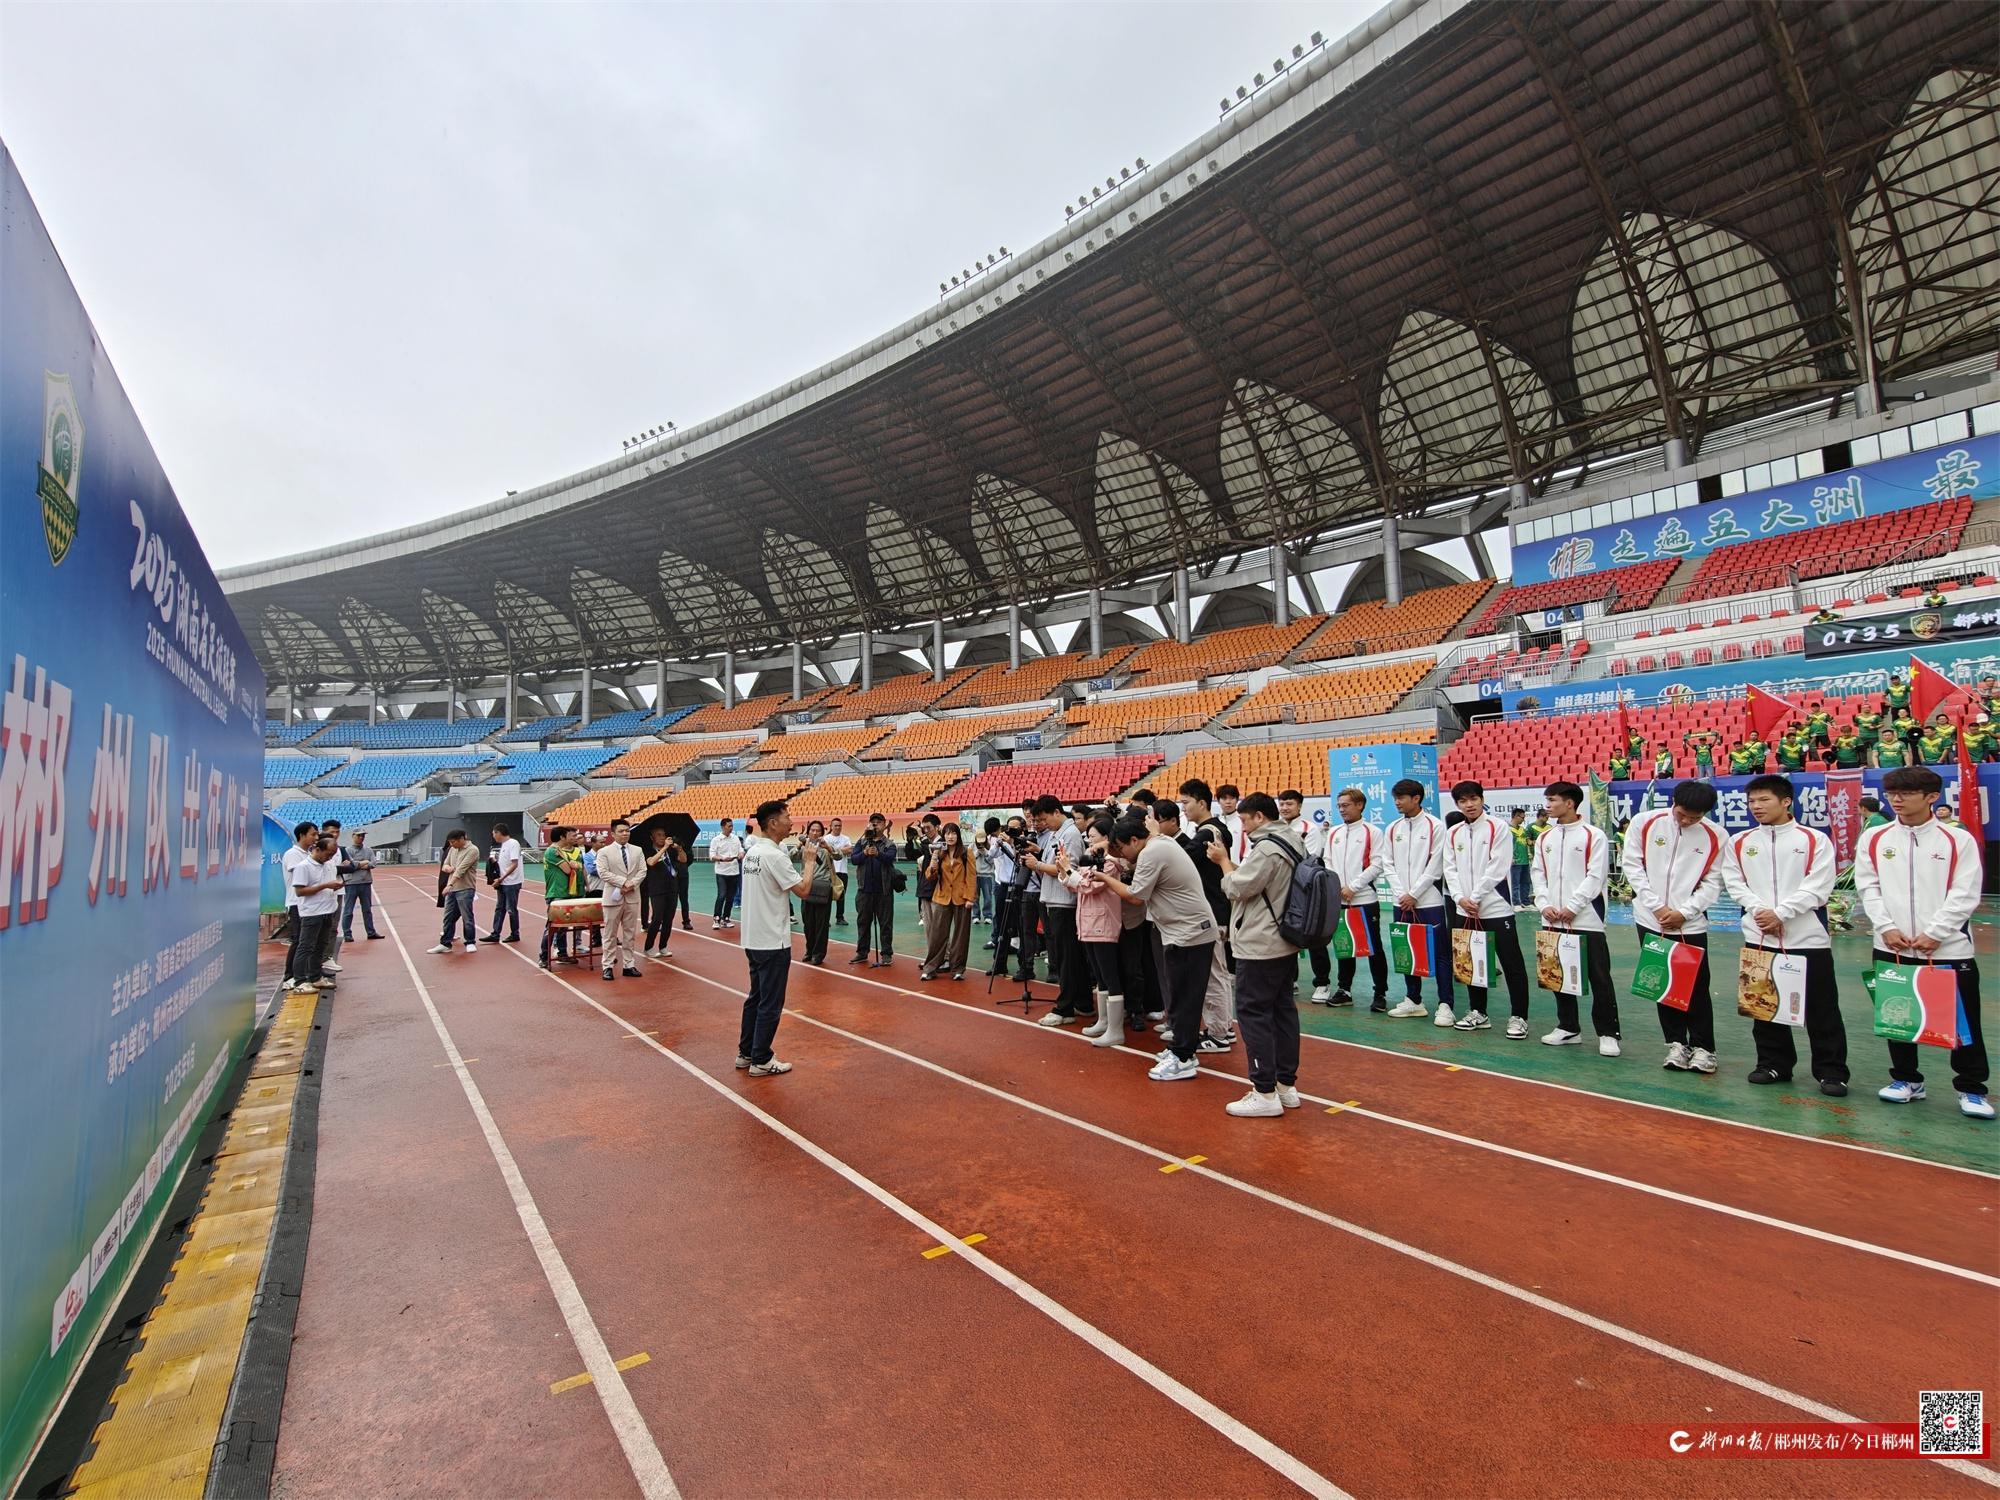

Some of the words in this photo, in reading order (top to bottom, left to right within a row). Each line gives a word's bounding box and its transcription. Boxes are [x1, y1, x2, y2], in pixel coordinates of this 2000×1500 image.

[1609, 476, 1864, 563] 走遍五大洲
[1923, 449, 1980, 499] 最
[146, 621, 166, 664] 2025
[166, 642, 189, 689] HUNAN
[189, 667, 213, 712] FOOTBALL
[1822, 623, 1900, 647] 0735
